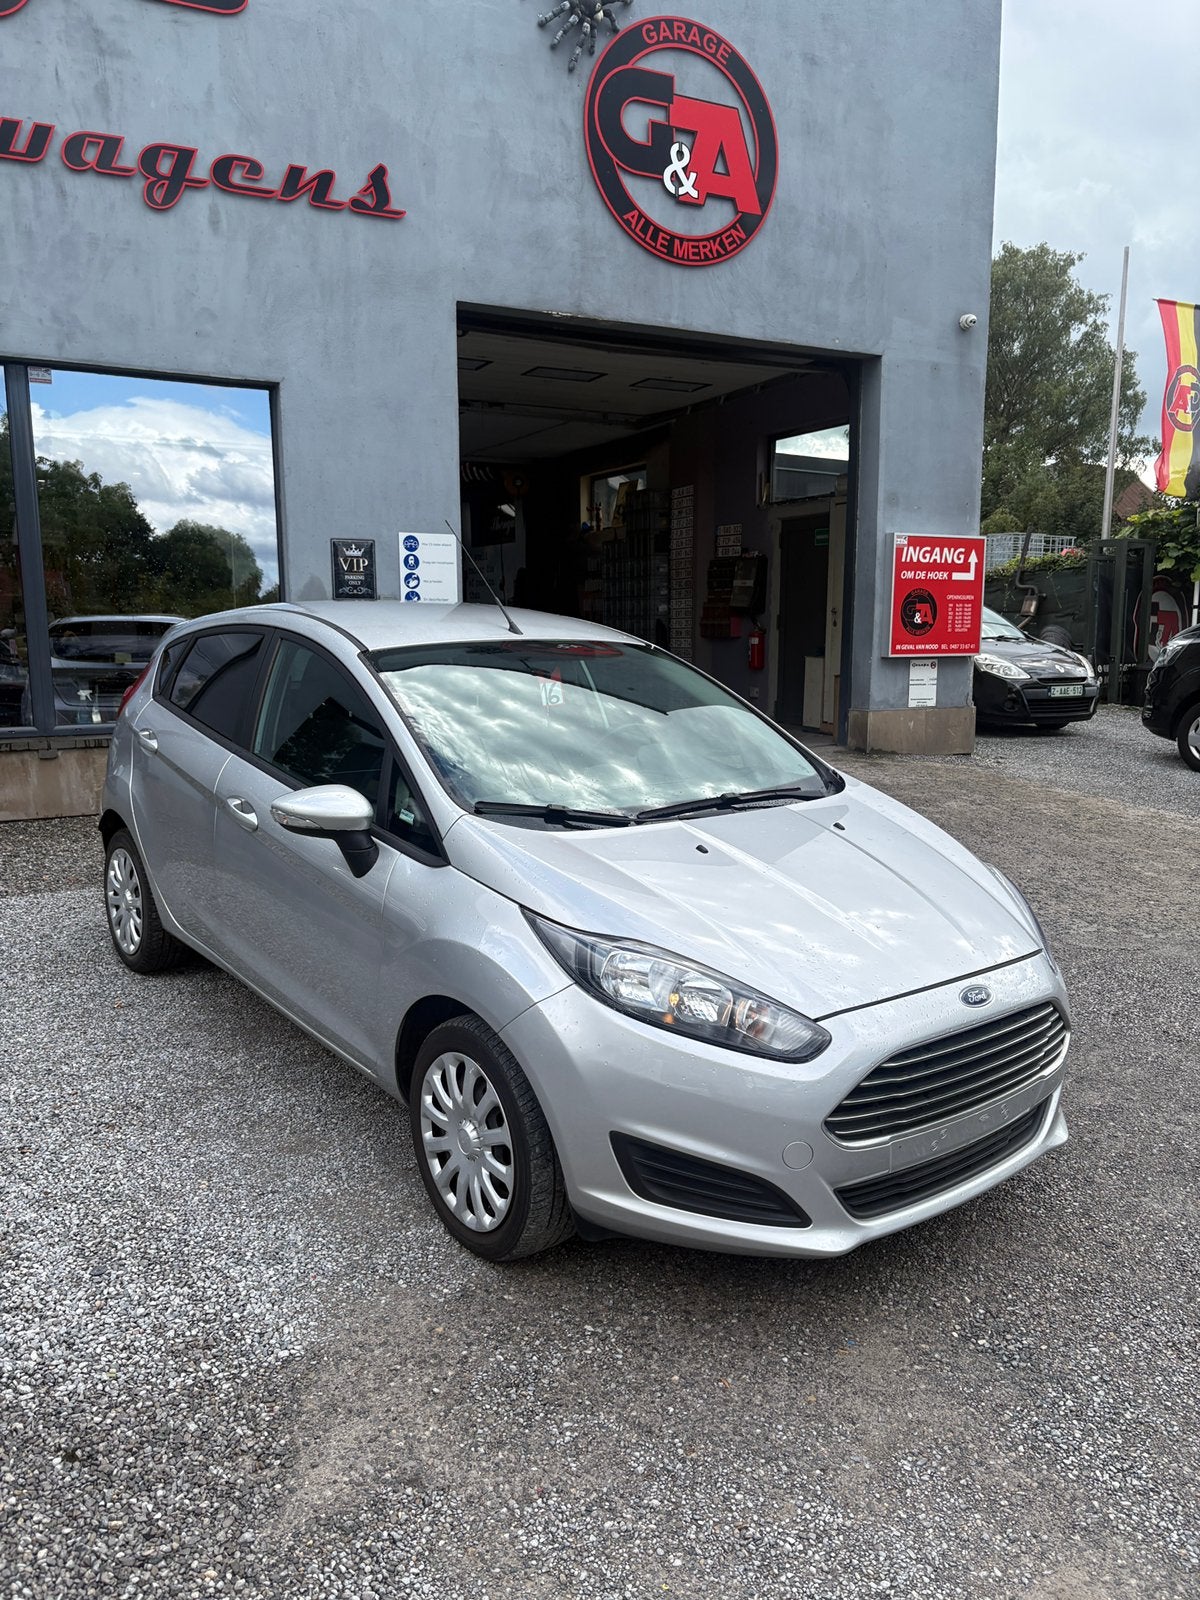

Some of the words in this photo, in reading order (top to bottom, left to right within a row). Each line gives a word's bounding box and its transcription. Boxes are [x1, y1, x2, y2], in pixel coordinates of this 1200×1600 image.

[642, 21, 732, 65] GARAGE
[623, 209, 670, 253] ALLE
[673, 223, 747, 261] MERKEN
[901, 546, 966, 564] INGANG
[339, 557, 369, 572] VIP
[900, 570, 914, 579] OM
[915, 571, 926, 580] DE
[927, 571, 949, 580] HOEK
[967, 990, 987, 1003] Ford
